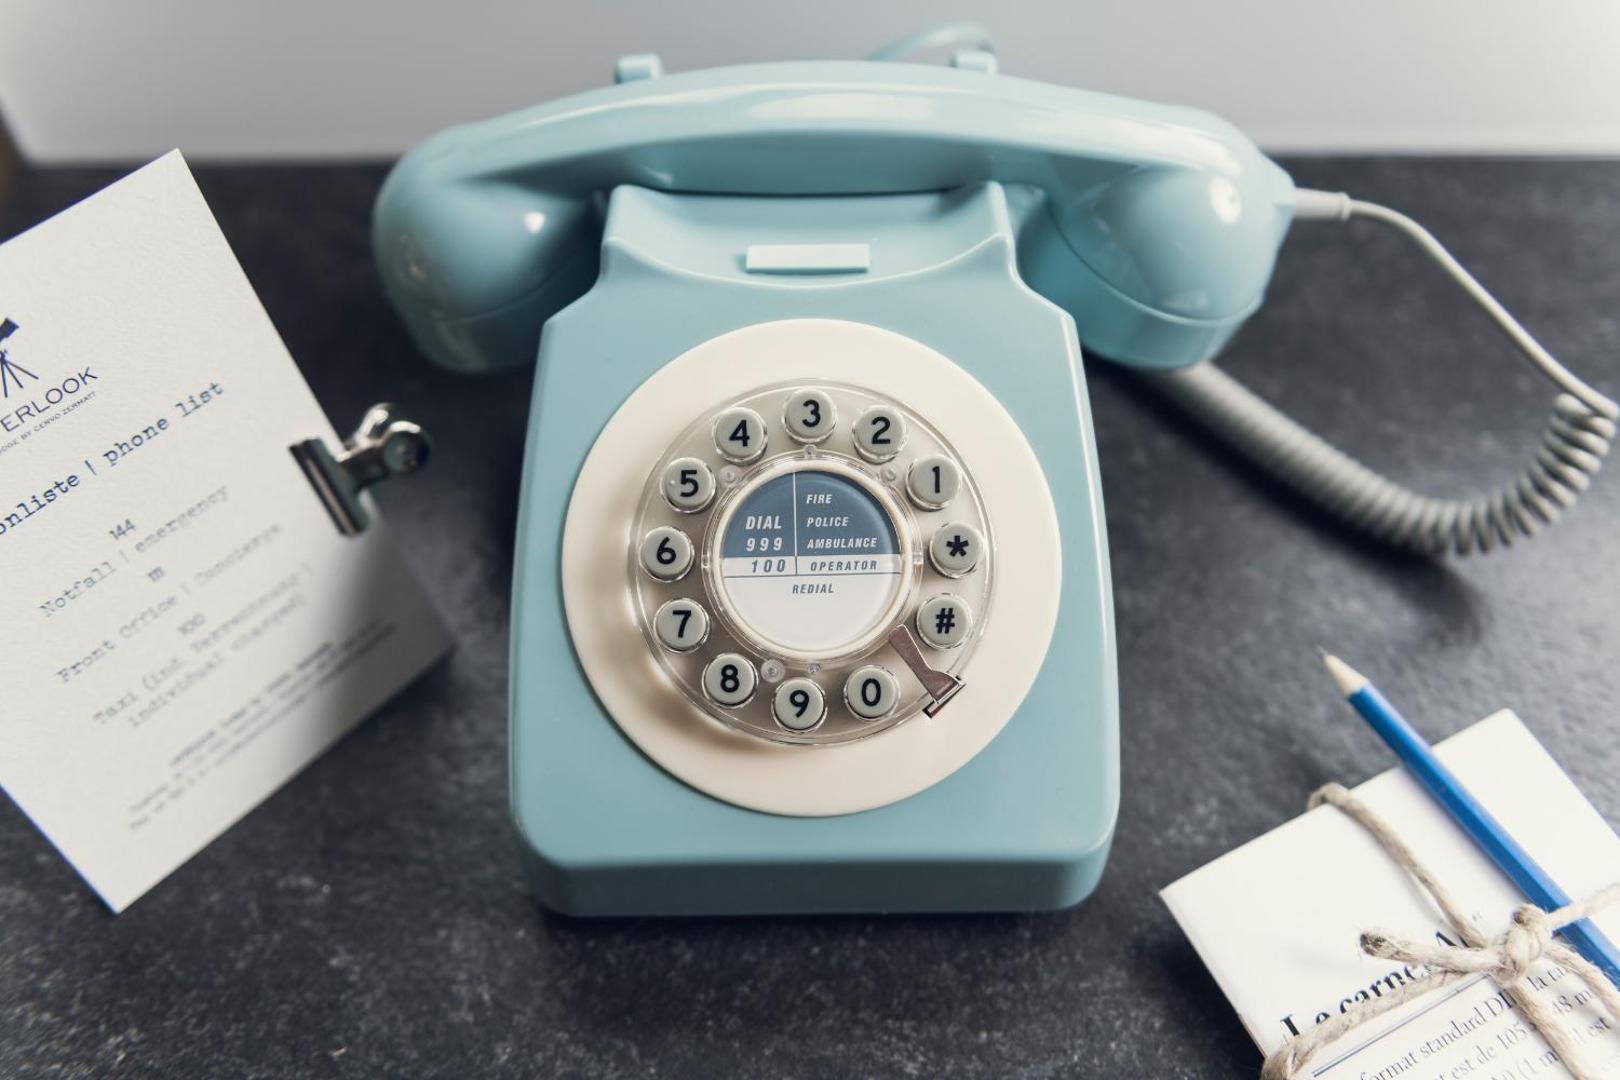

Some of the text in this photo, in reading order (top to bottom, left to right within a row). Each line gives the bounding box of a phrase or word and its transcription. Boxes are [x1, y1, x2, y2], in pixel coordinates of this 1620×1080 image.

[103, 417, 169, 467] phone
[175, 381, 224, 418] list
[802, 399, 821, 427] 3
[729, 420, 750, 447] 4
[871, 416, 891, 444] 2
[680, 470, 699, 497] 5
[932, 466, 941, 493] 1
[806, 494, 832, 504] FIRE
[109, 518, 136, 540] 144
[745, 516, 782, 530] DIAL
[806, 517, 849, 528] POLICE
[39, 561, 117, 617] Notfall
[134, 485, 228, 553] emergency
[656, 537, 677, 564] 6
[746, 537, 783, 551] 999
[806, 537, 878, 549] AMBULANCE
[751, 559, 877, 573] 100 OPERATOR
[792, 584, 834, 594] REDIAL
[672, 610, 692, 638] 7
[57, 640, 115, 682] Front
[119, 596, 176, 640] Office
[721, 664, 739, 692] 8
[790, 690, 809, 718] 9
[861, 678, 881, 706] 0
[92, 691, 138, 725] Taxi
[1420, 1005, 1487, 1058] standard
[1476, 1045, 1496, 1065] de
